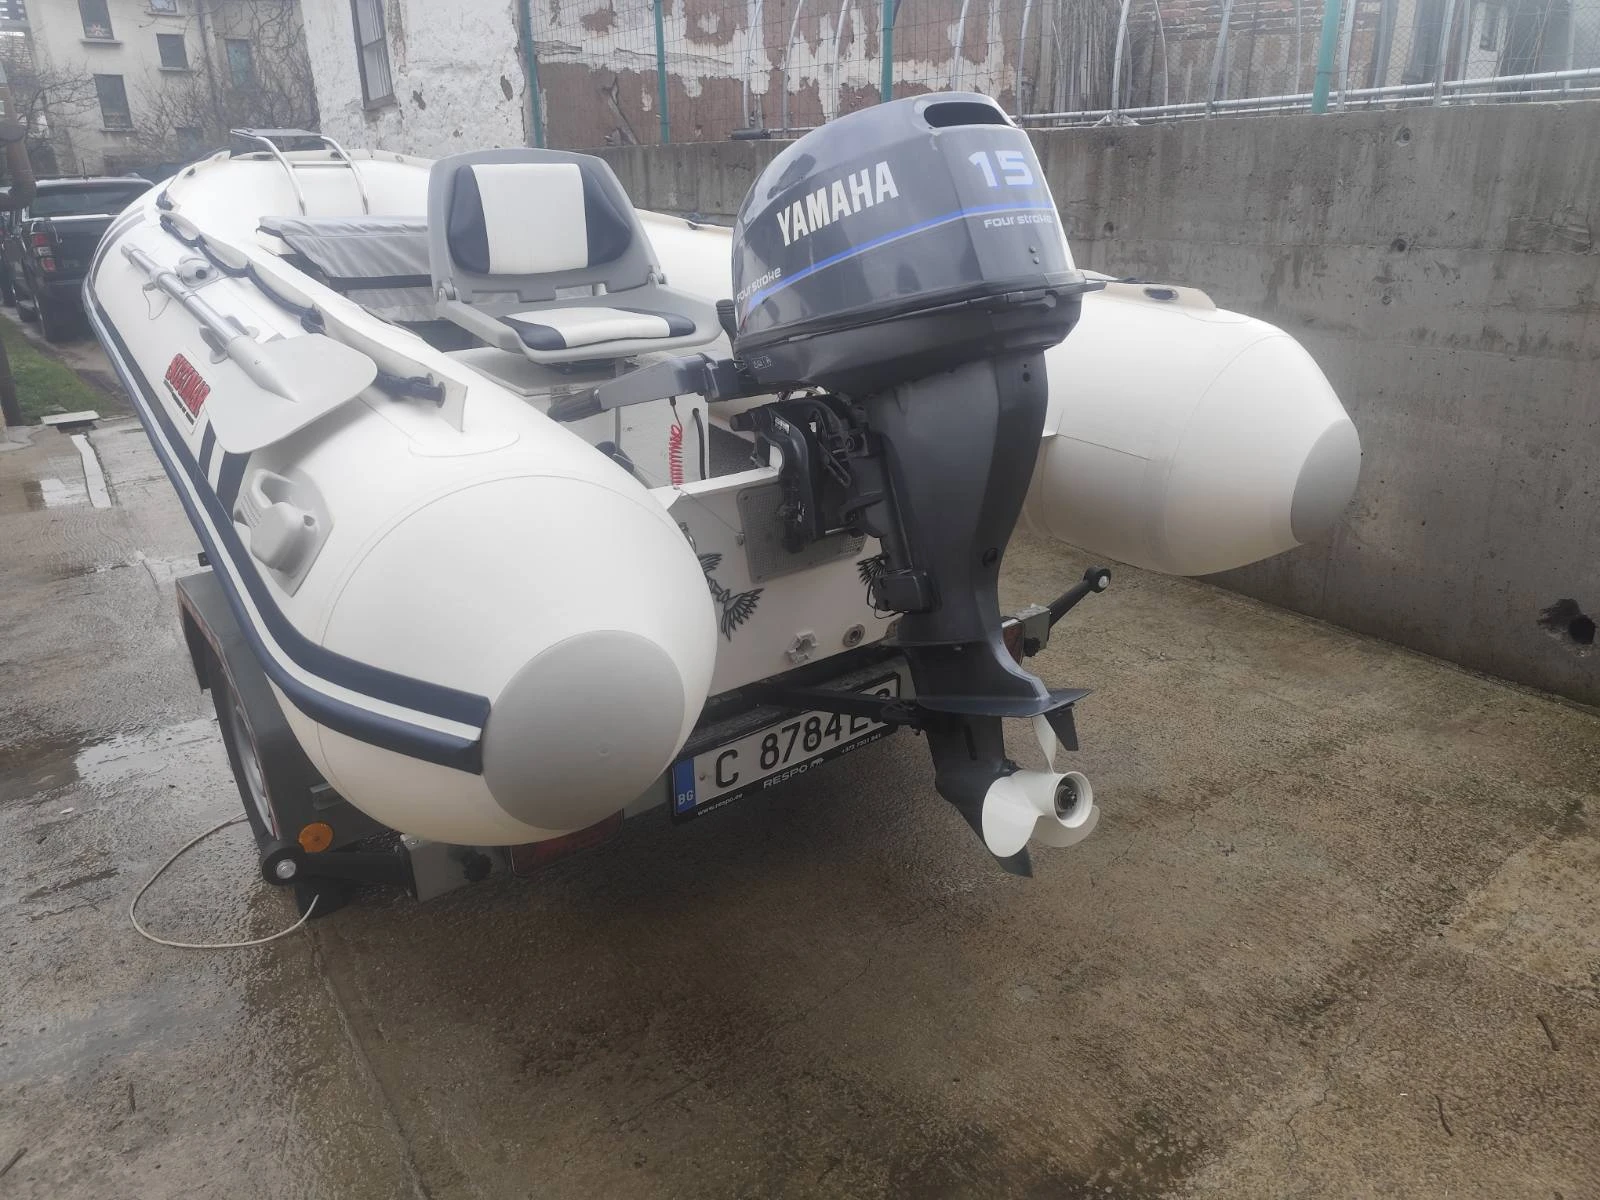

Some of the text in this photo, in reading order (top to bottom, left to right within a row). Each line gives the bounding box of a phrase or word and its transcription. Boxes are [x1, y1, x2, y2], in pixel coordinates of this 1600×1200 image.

[968, 150, 1034, 189] 15
[776, 161, 899, 247] YAMAHA
[715, 748, 739, 788] C
[759, 711, 843, 770] 8784
[763, 763, 808, 789] RESPO
[678, 789, 694, 806] BG
